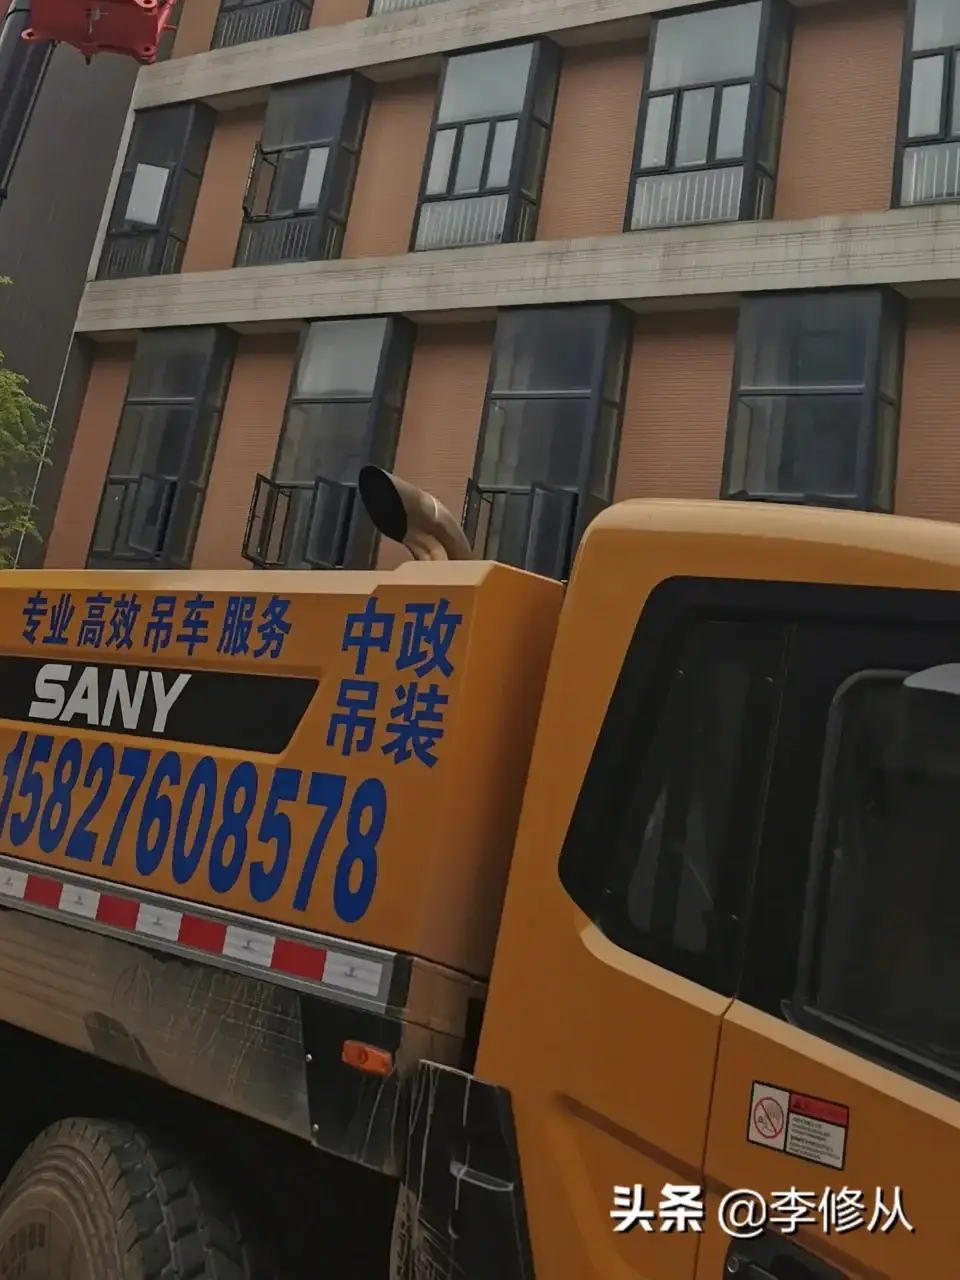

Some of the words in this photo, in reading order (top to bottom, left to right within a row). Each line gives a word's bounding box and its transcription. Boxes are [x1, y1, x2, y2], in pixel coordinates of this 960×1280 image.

[22, 590, 292, 659] 专业高效吊车服务
[341, 596, 463, 679] 中政
[28, 663, 192, 733] SANY
[326, 678, 449, 769] 吊装
